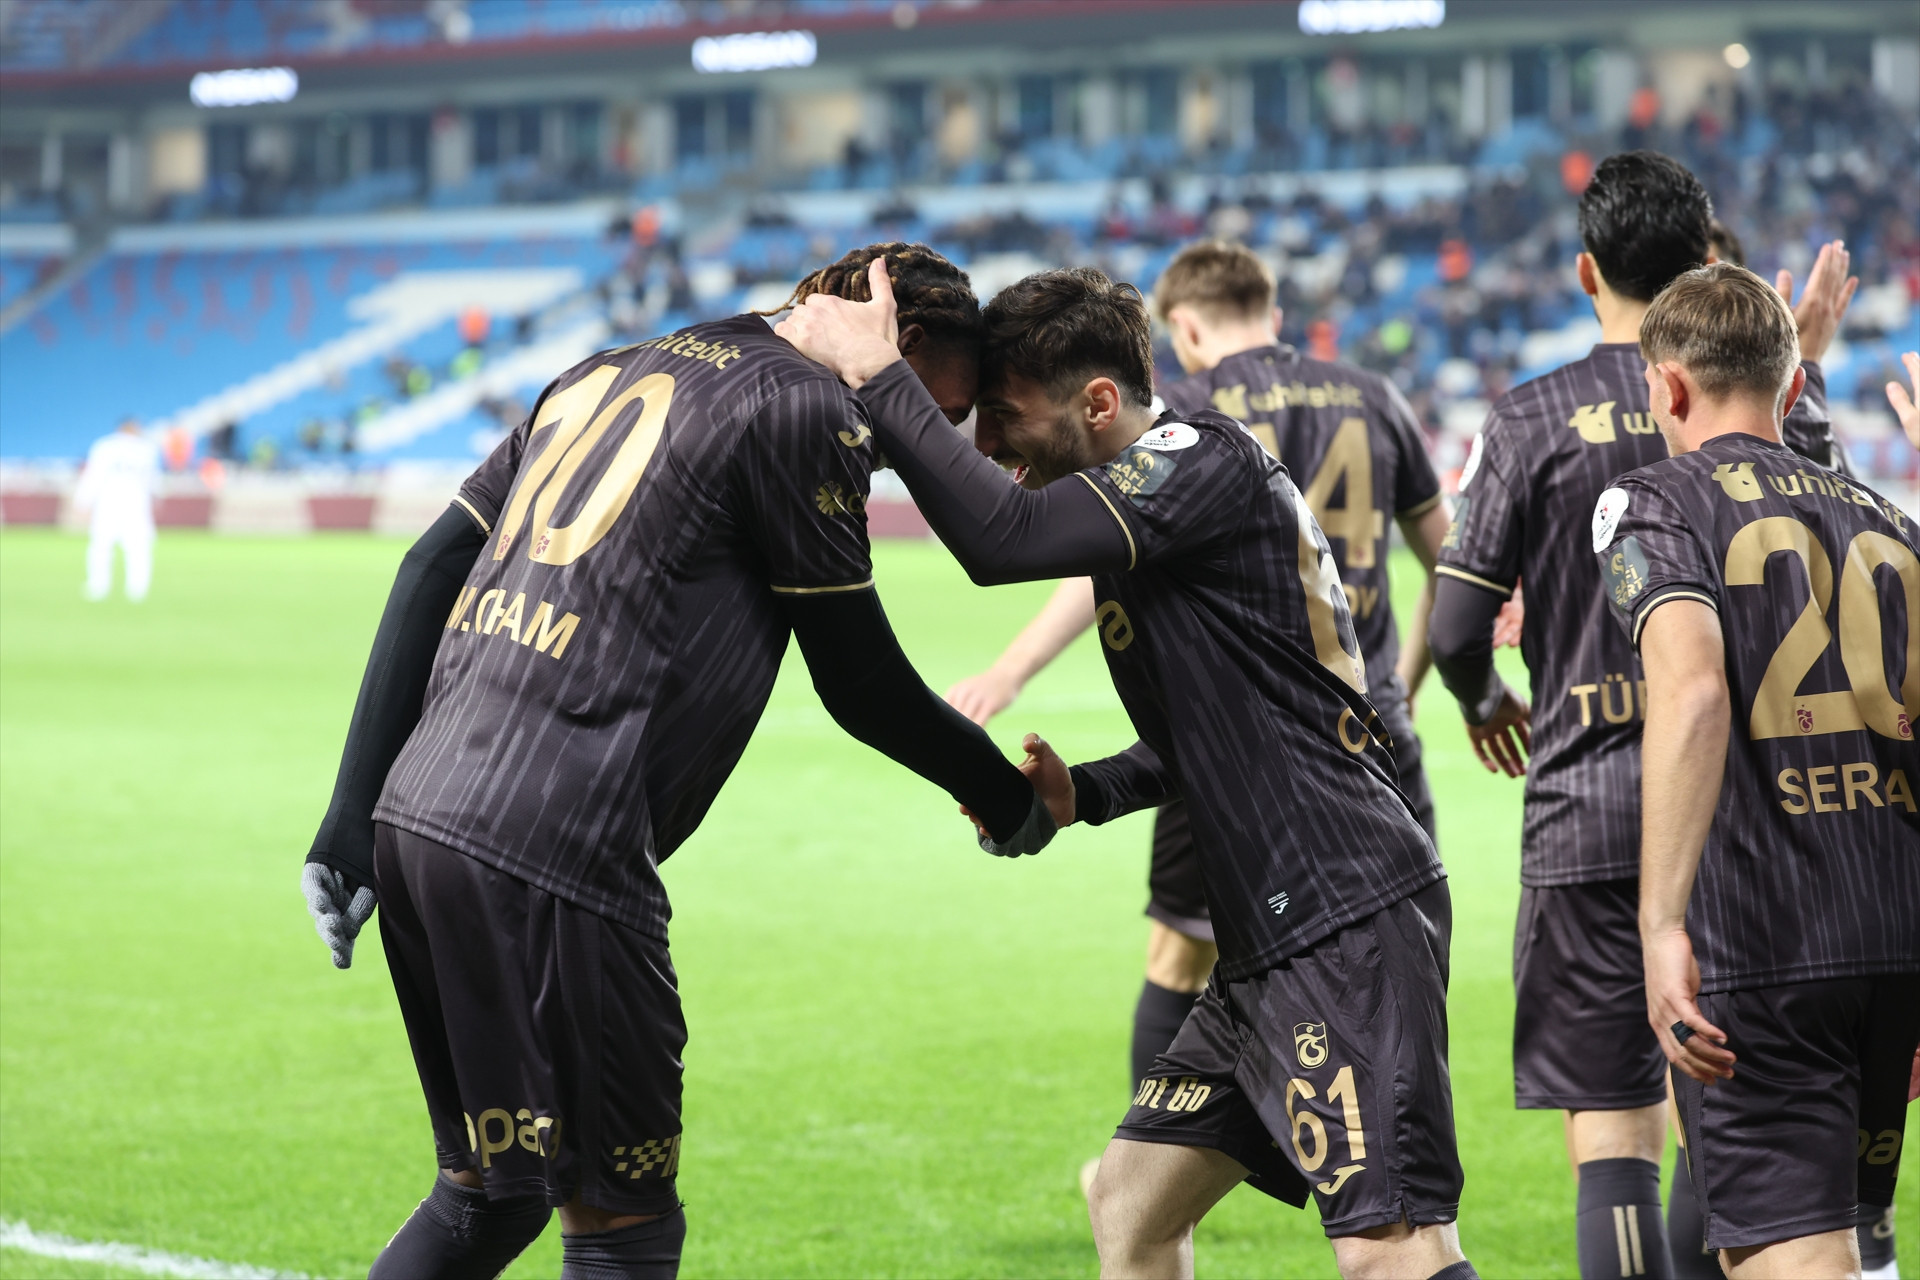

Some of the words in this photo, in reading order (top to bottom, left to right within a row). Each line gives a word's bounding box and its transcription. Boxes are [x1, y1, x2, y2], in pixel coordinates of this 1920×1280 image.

[493, 364, 676, 566] 10
[1725, 516, 1920, 741] 20
[1777, 762, 1918, 815] SERA
[1166, 1076, 1212, 1113] Go
[1285, 1065, 1367, 1172] 61
